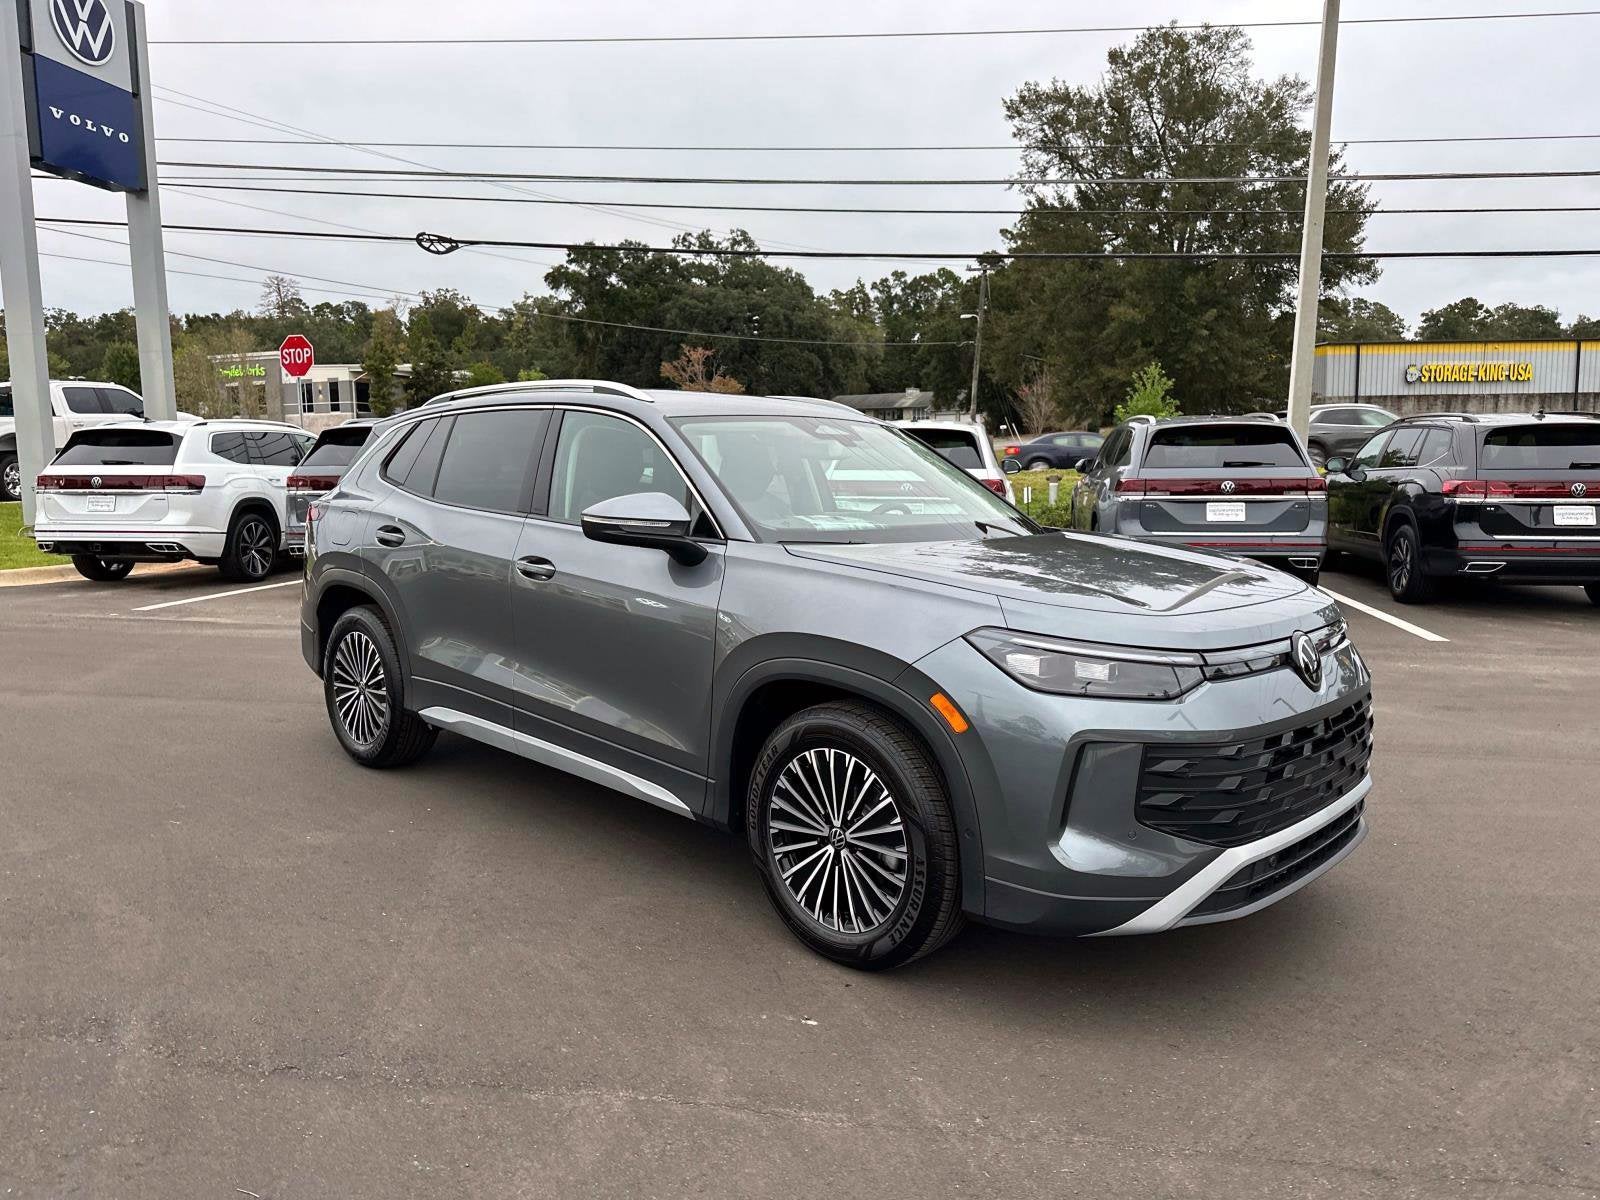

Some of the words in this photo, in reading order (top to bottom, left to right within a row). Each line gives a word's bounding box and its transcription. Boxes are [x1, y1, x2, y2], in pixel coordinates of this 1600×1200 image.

[49, 106, 129, 143] VOLVO
[282, 348, 311, 364] STOP
[887, 855, 925, 946] ASSURANCE
